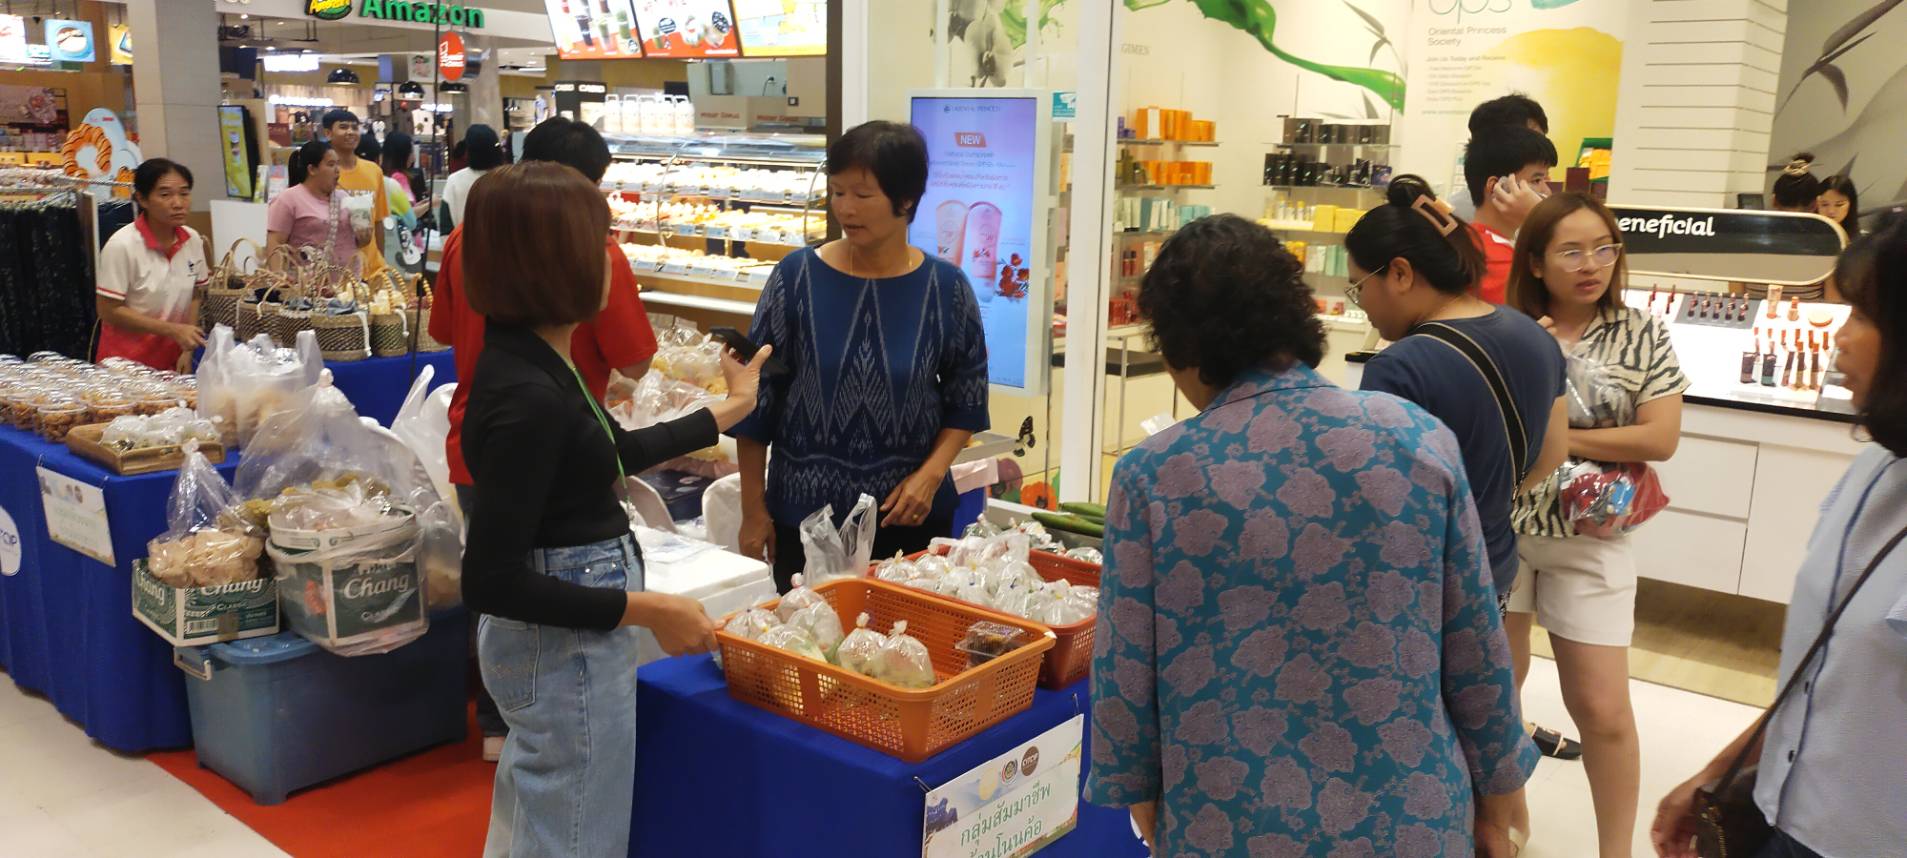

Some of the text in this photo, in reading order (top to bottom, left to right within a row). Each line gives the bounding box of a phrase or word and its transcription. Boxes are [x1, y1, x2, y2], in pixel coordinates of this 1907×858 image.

[360, 0, 485, 28] Amazon
[1427, 37, 1462, 47] Society
[1467, 26, 1507, 35] Princess
[960, 134, 982, 145] NEW
[1614, 214, 1716, 239] eneficial
[343, 573, 410, 600] Chang
[961, 779, 1051, 847] กลุ่มสัมมาชีพ
[970, 815, 1042, 858] ้านโนนค้อ
